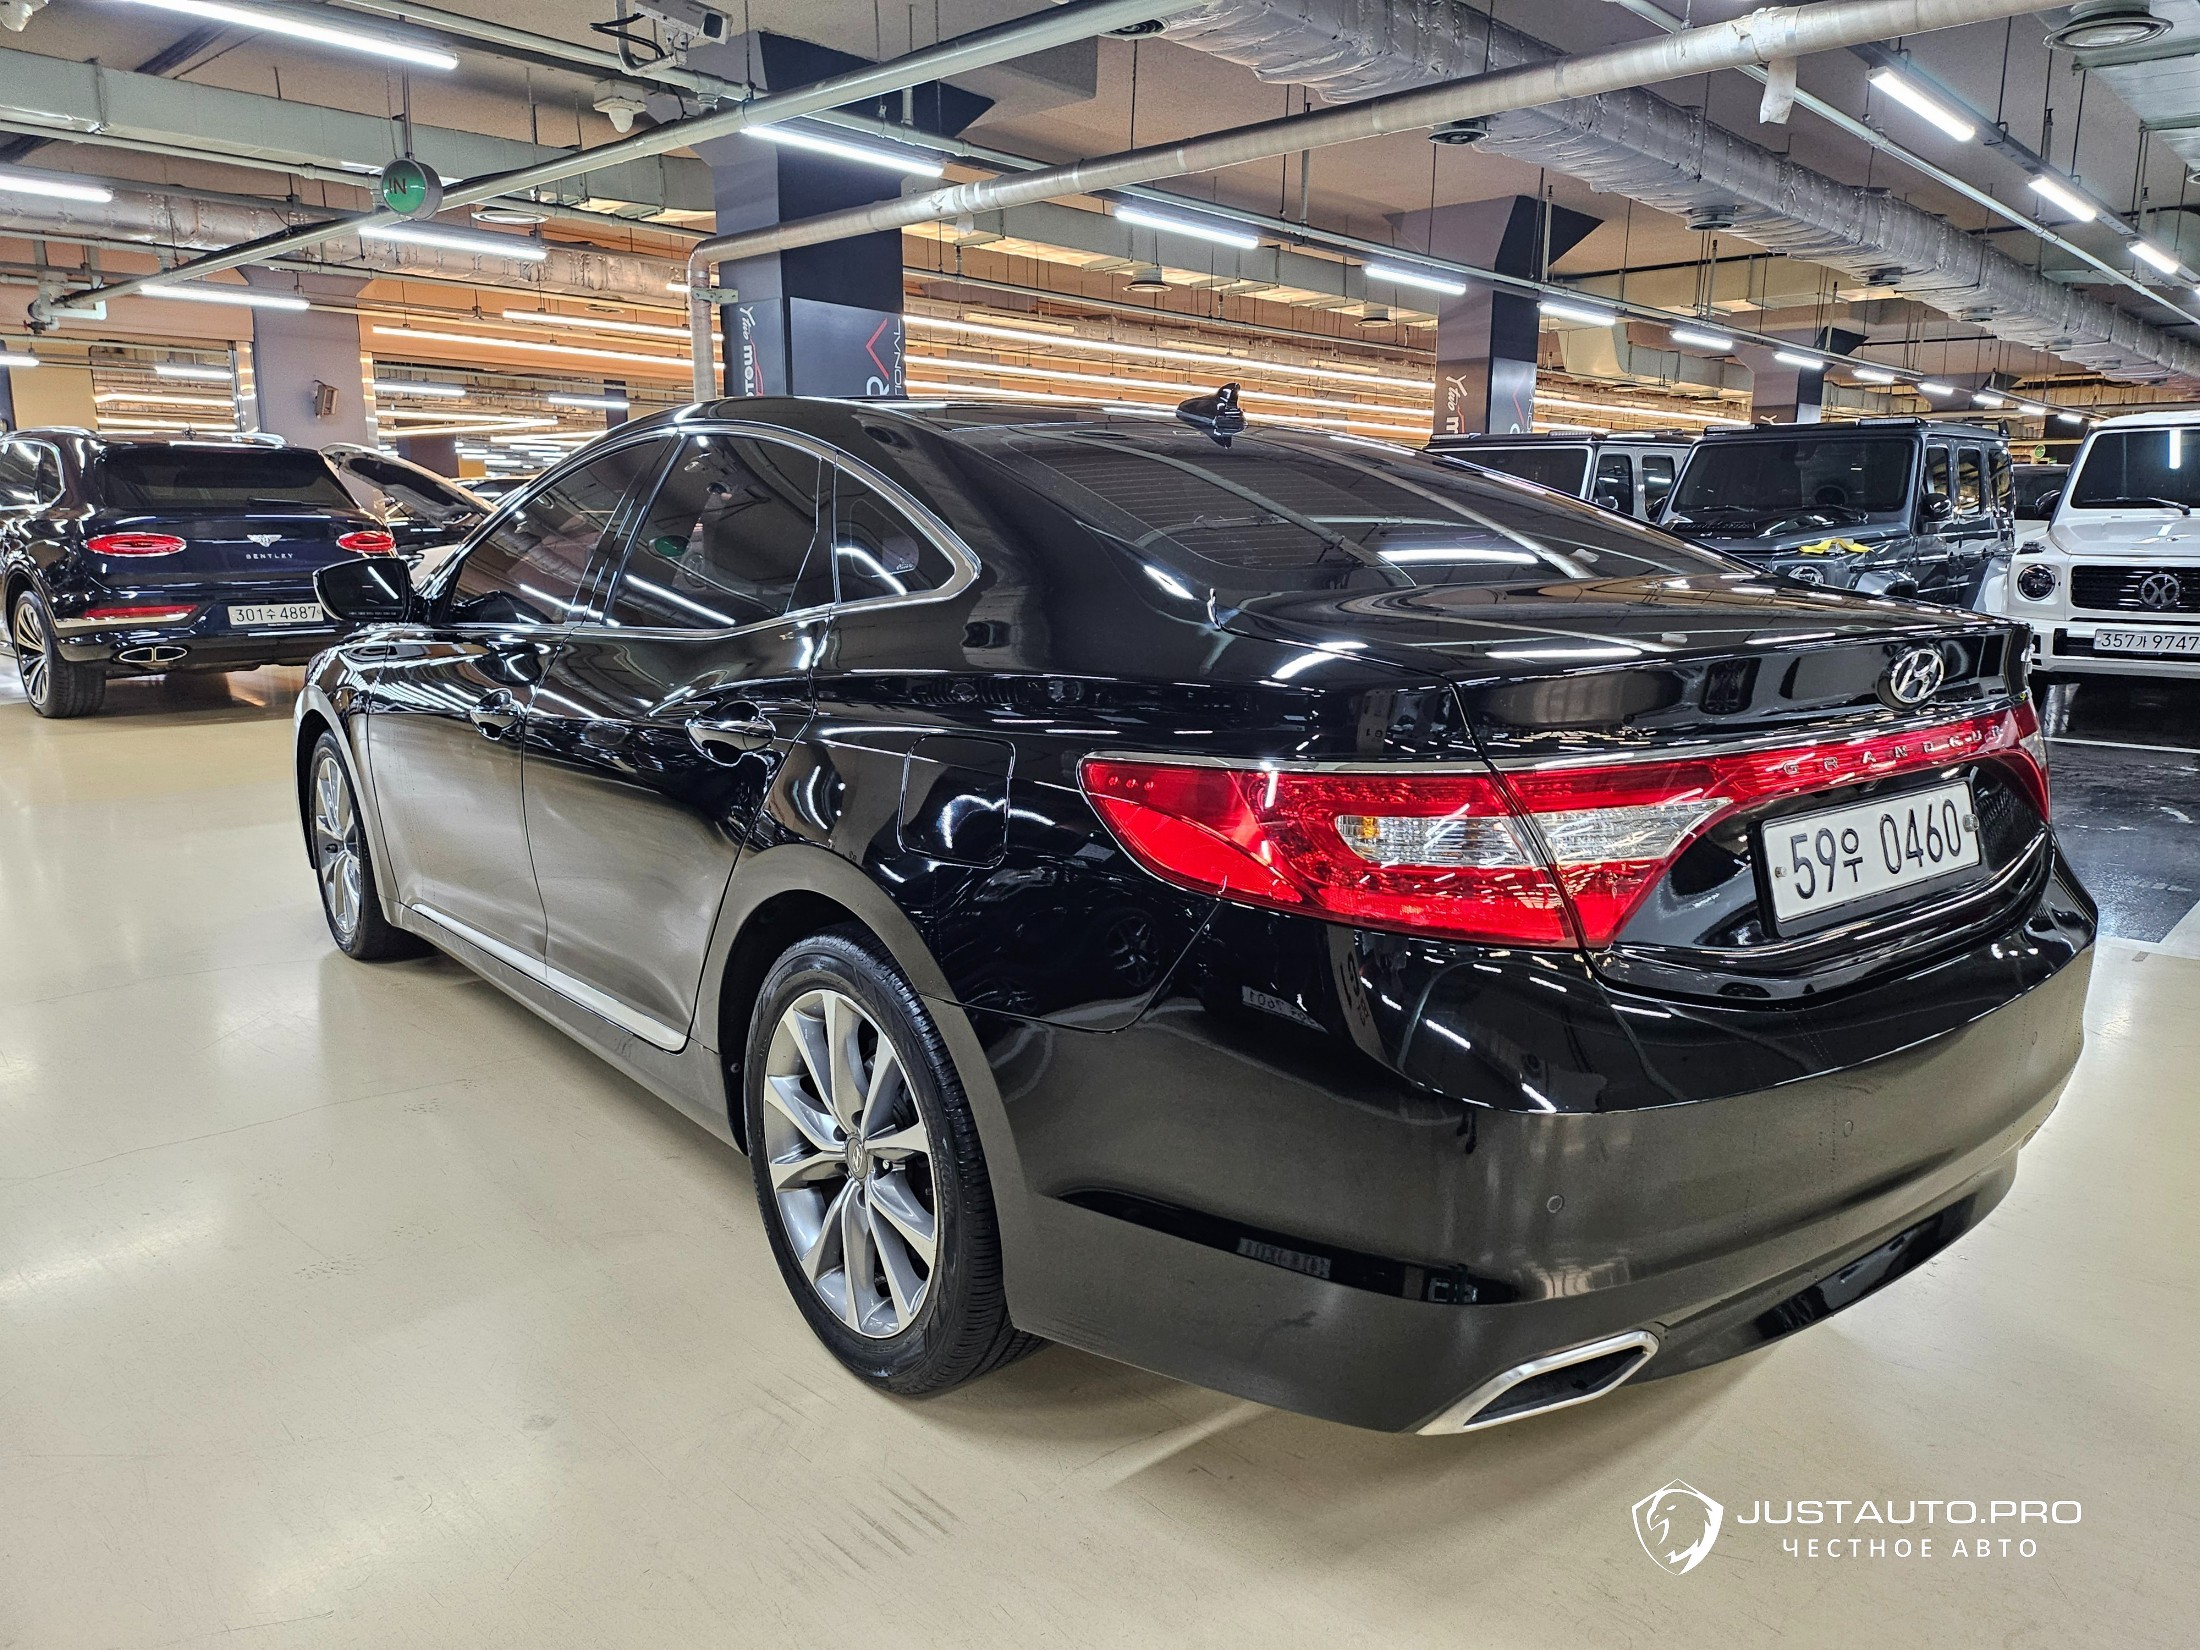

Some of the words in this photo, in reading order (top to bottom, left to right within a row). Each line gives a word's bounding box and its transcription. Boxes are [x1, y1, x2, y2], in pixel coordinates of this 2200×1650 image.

[388, 176, 407, 195] IN
[245, 552, 295, 560] BENTLEY
[235, 608, 276, 622] 301수
[280, 605, 317, 620] 4887
[2101, 633, 2148, 648] 357가
[2152, 634, 2200, 651] 9747
[1790, 827, 1864, 900] 59우
[1880, 799, 1962, 875] 0460
